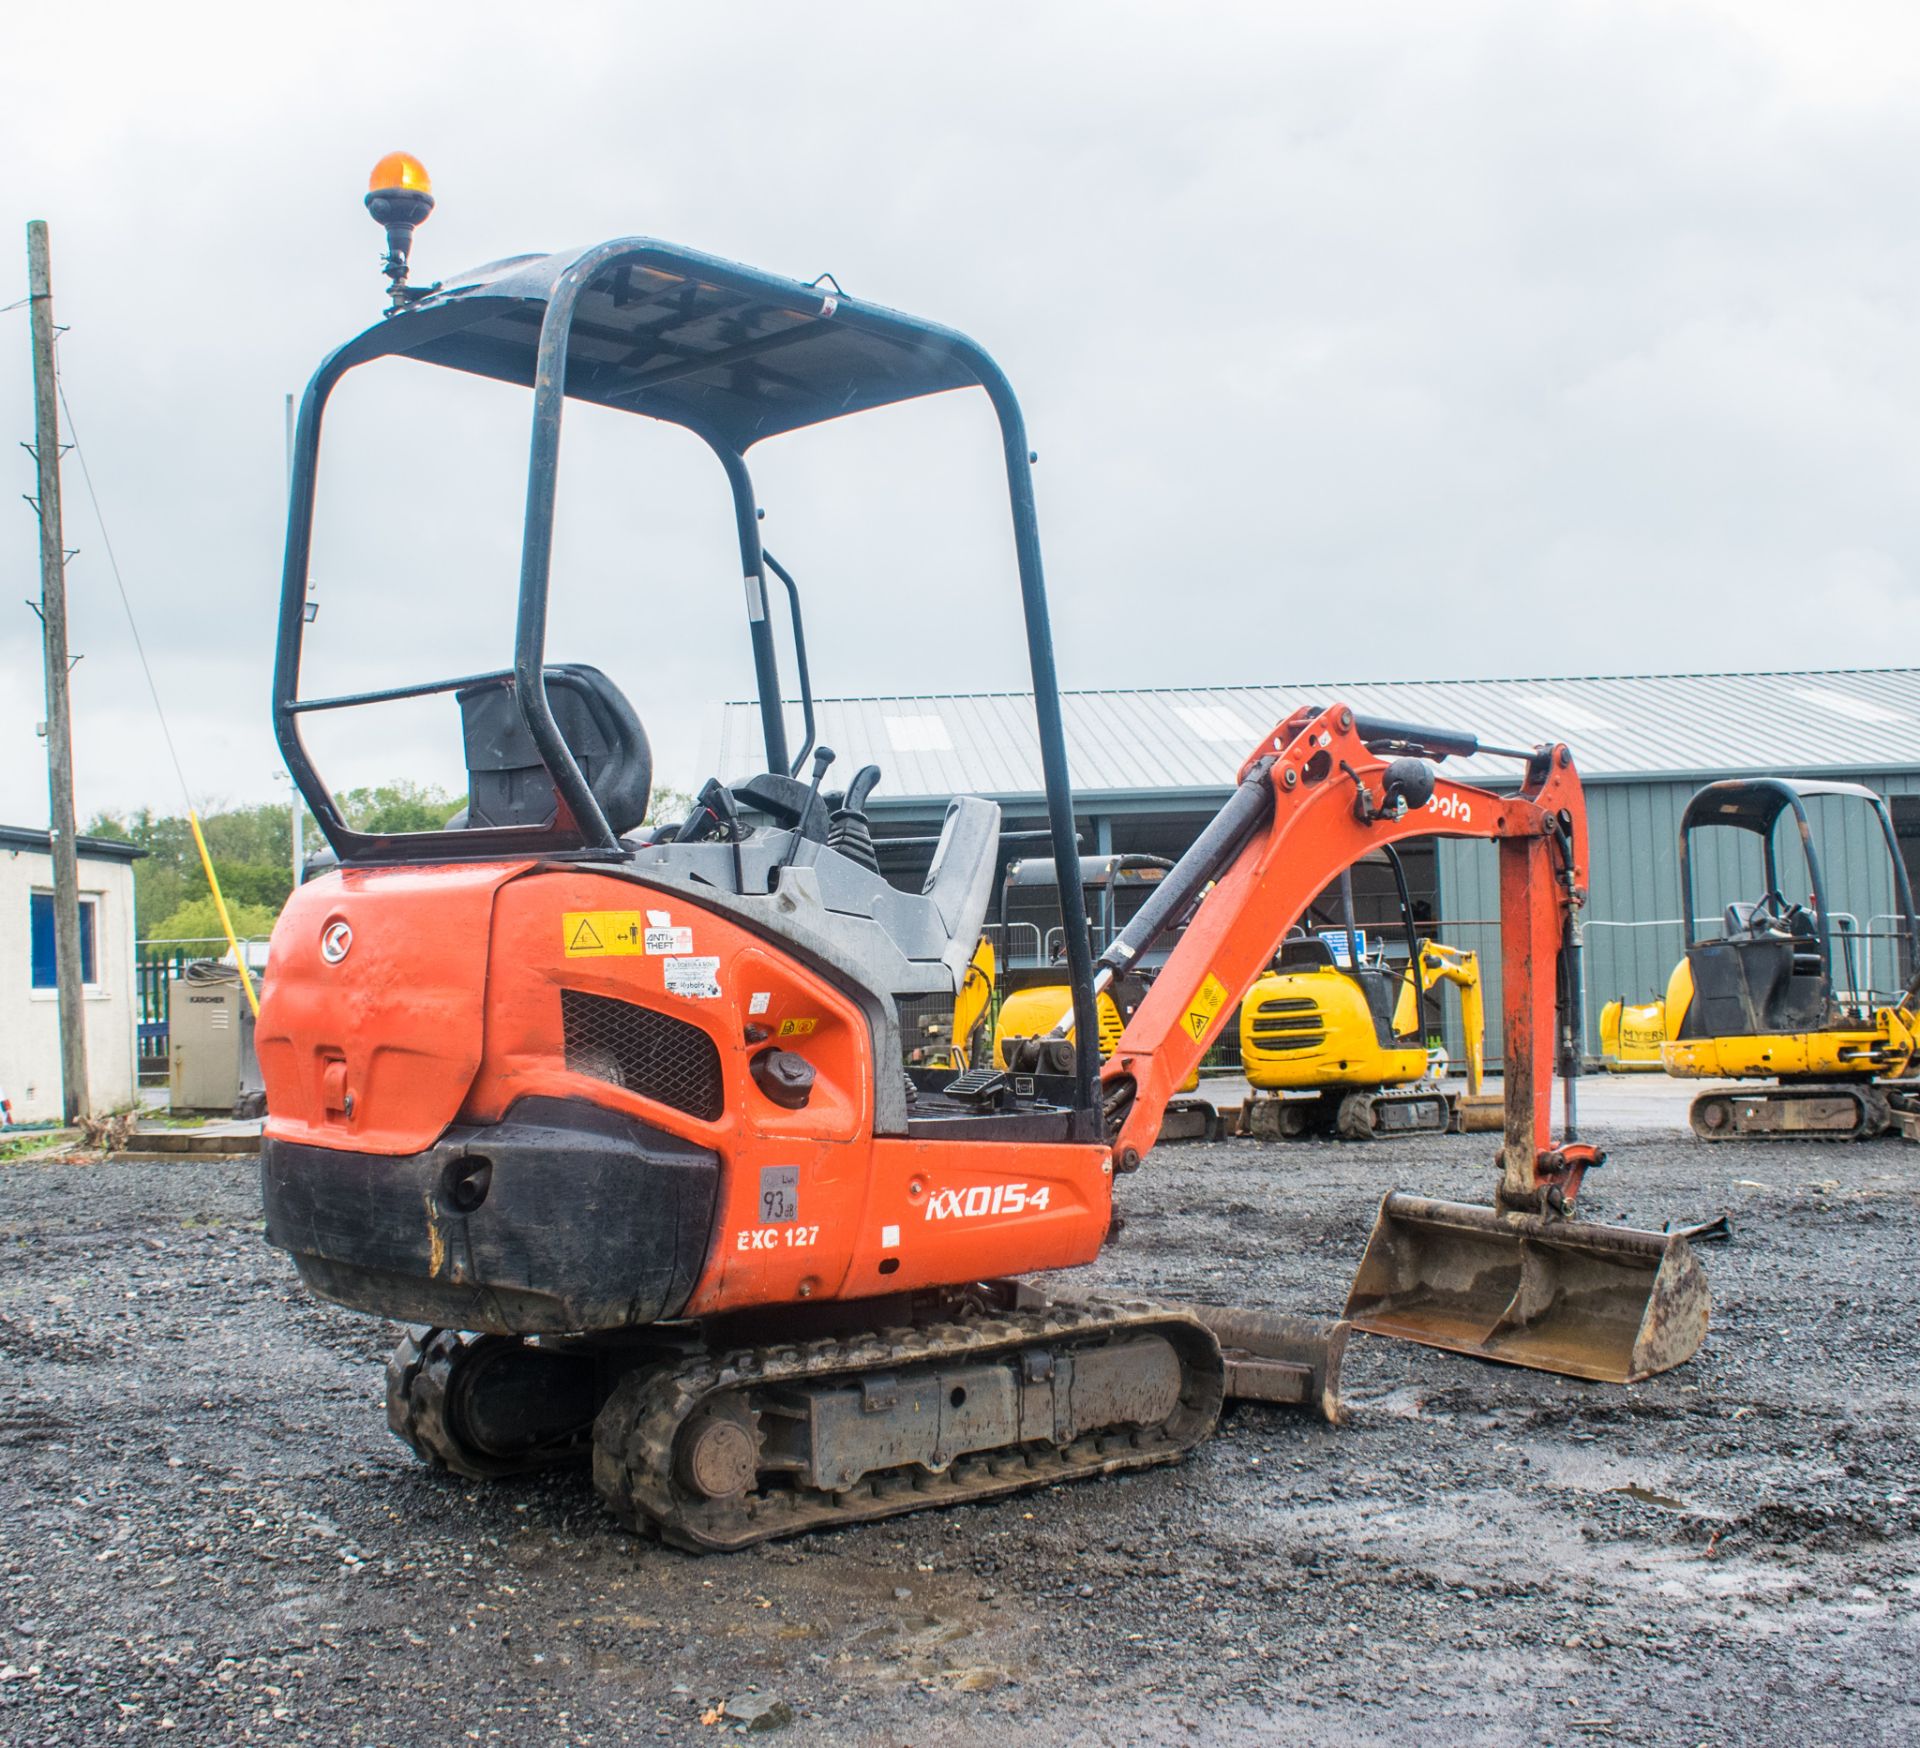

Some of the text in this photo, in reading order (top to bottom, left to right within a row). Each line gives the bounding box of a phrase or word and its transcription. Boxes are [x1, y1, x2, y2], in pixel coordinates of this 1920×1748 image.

[646, 942, 674, 950] THEFT
[1623, 1029, 1664, 1041] MYERS
[763, 1190, 784, 1219] 93
[737, 1225, 820, 1251] EXC 127
